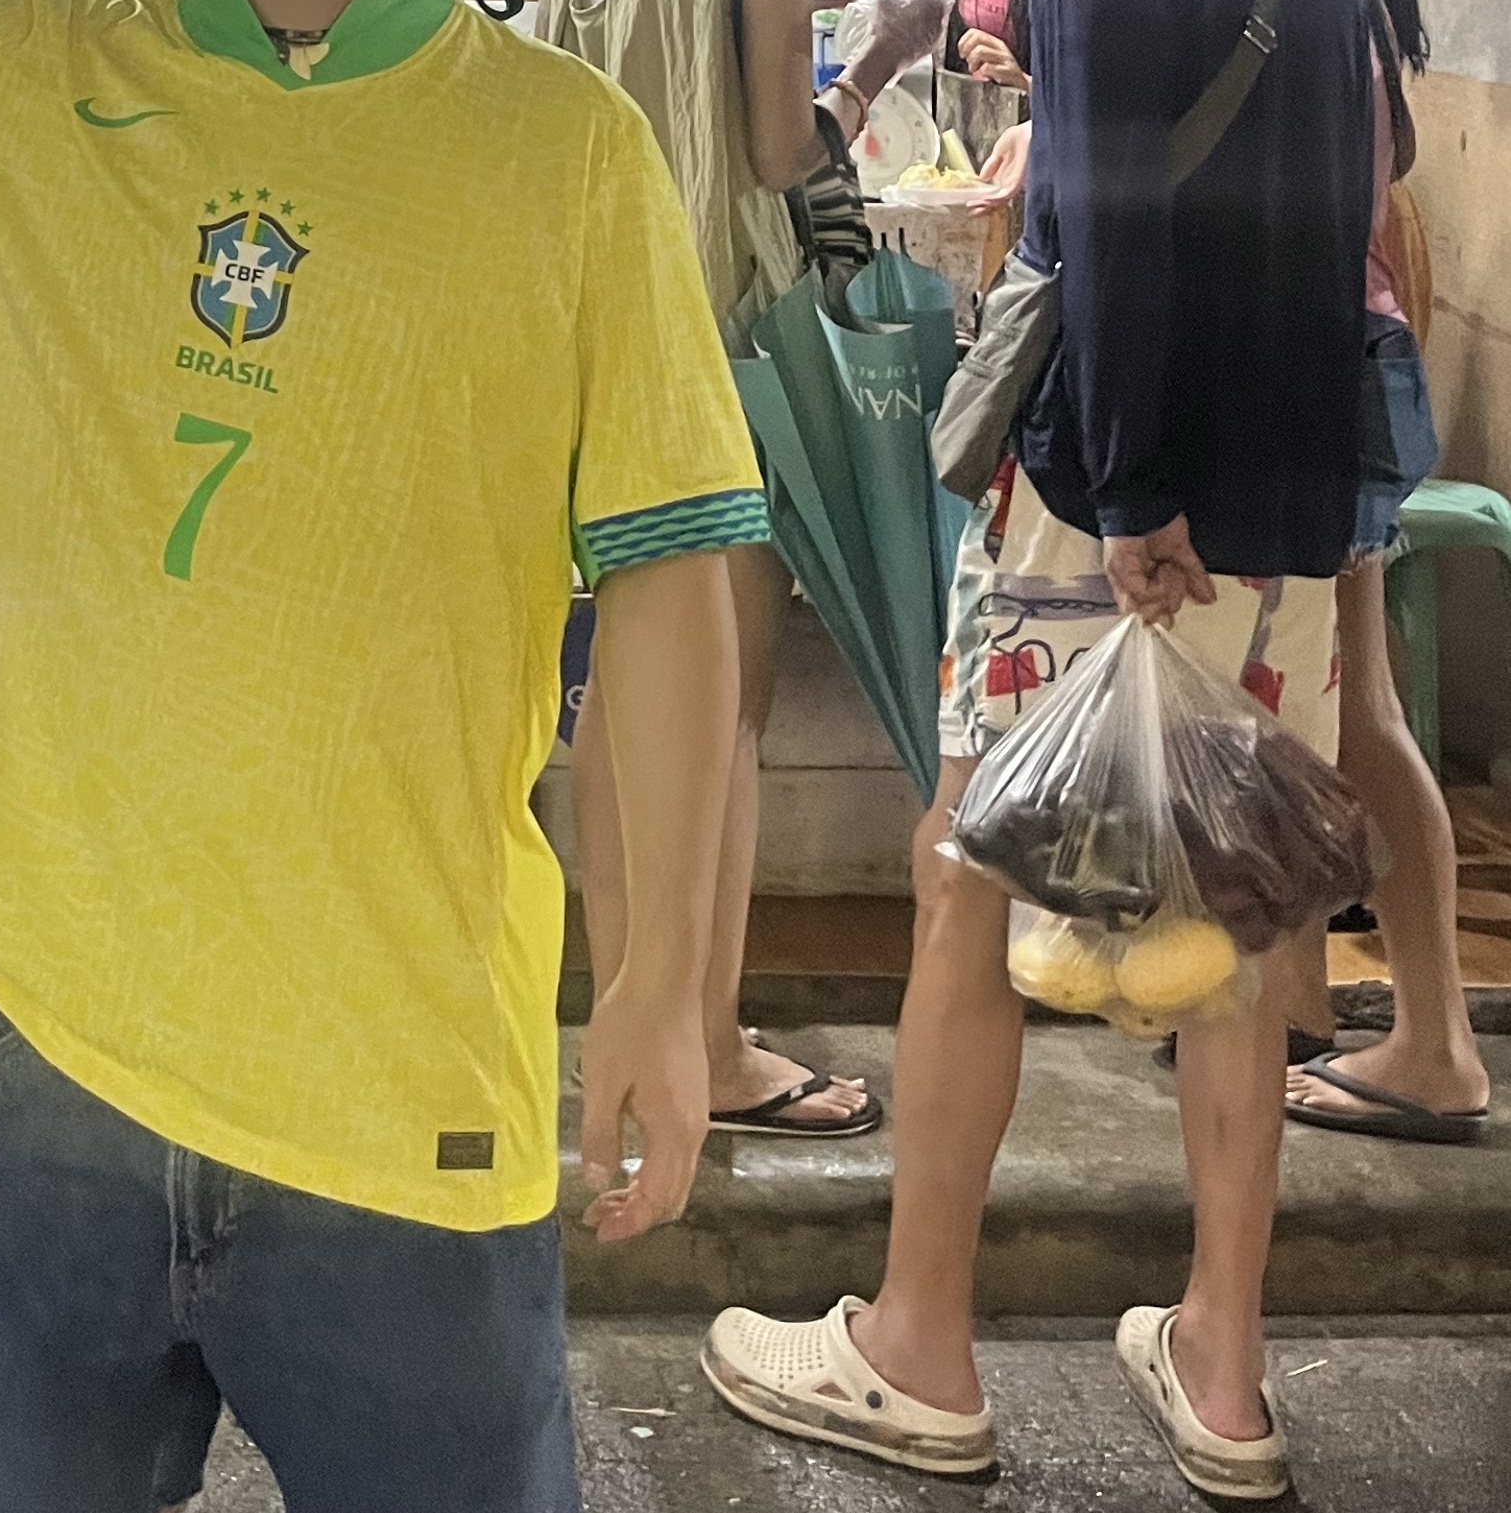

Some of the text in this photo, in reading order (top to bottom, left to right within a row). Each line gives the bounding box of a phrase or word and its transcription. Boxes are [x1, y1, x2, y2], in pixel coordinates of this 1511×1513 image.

[224, 262, 265, 285] CBF
[175, 344, 279, 394] BRASIL
[163, 412, 253, 582] 7
